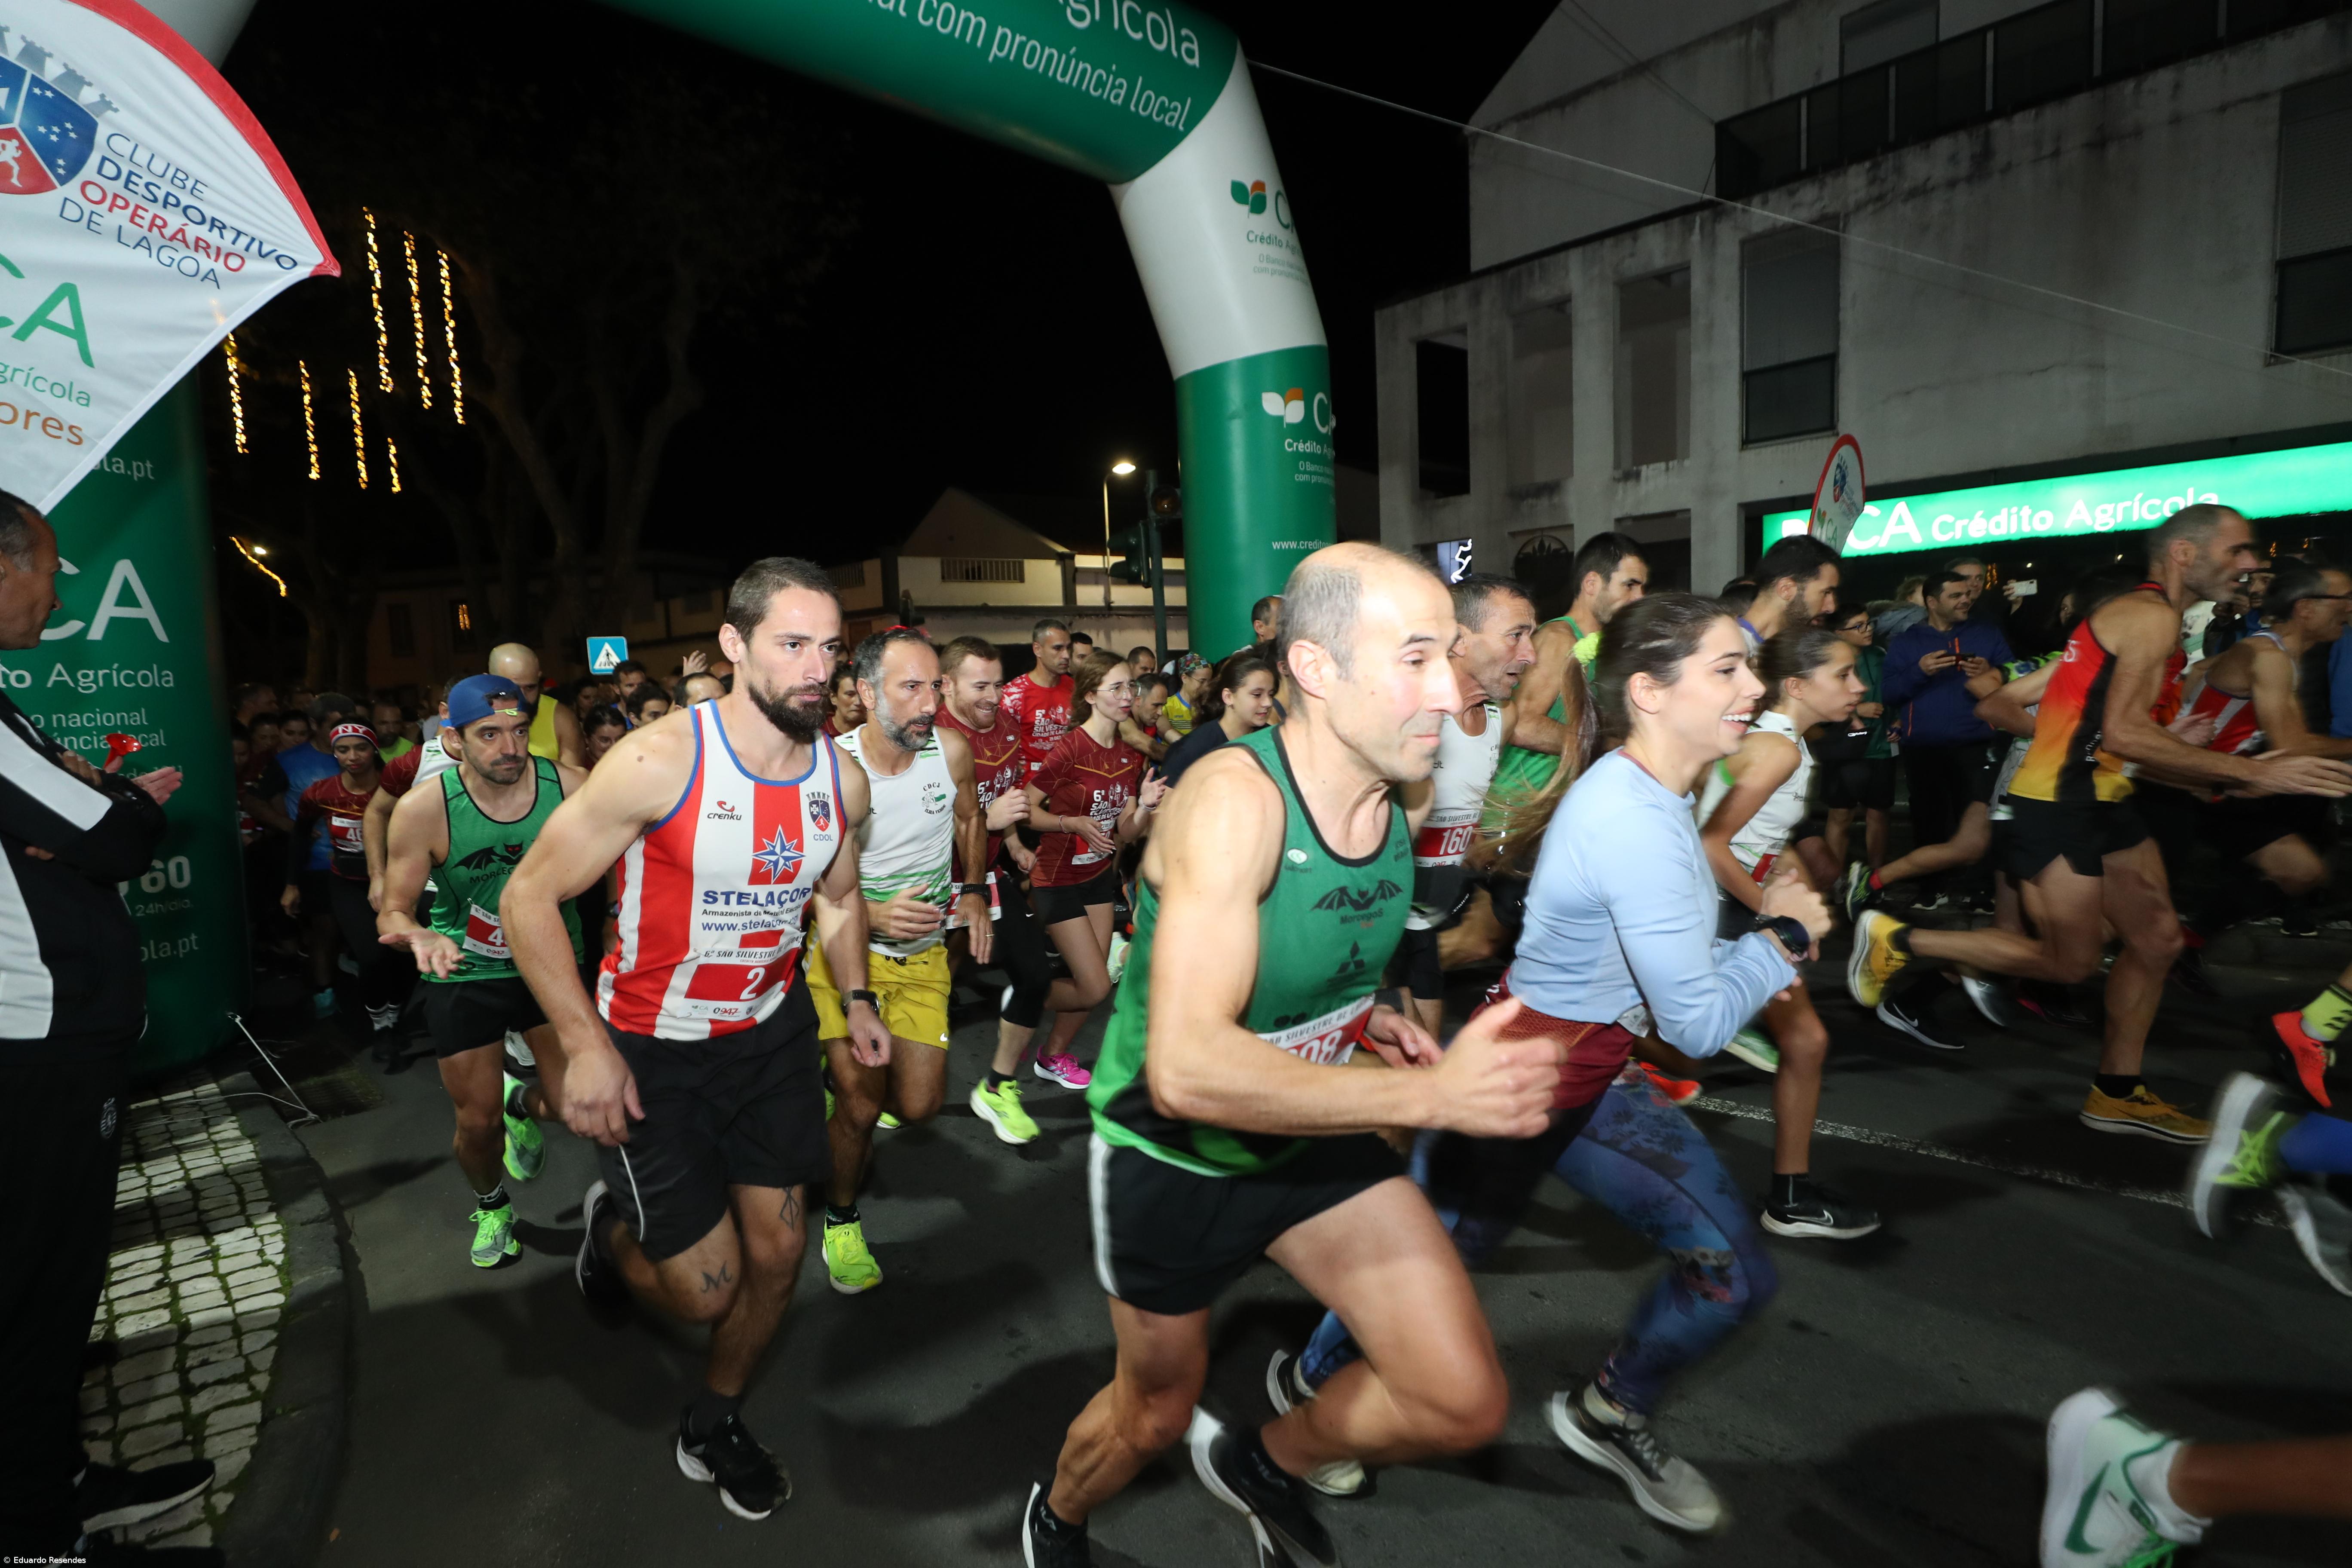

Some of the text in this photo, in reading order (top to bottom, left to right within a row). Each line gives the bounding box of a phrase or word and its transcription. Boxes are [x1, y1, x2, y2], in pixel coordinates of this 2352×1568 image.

[918, 0, 1191, 131] com pronúncia local
[107, 133, 208, 201] CLUBE
[97, 155, 297, 270] DESPORTIVO
[1275, 190, 1294, 233] C
[80, 181, 245, 272] OPERÁRIO
[60, 197, 220, 289] DE LAGOA
[1247, 230, 1283, 248] Crédito
[1285, 438, 1322, 454] Crédito
[1299, 461, 1305, 470] O
[1306, 461, 1324, 473] Banco
[1295, 473, 1311, 482] com
[1847, 501, 1922, 550] CA
[1932, 506, 2054, 542] Crédito
[2064, 487, 2220, 532] Agrícola
[46, 662, 175, 694] Agrícola
[52, 707, 149, 727] nacional
[337, 725, 367, 734] NY
[923, 782, 940, 791] CDCJ
[978, 792, 992, 803] ÃO
[1090, 800, 1108, 811] SÃO
[707, 812, 742, 821] crenku
[1447, 813, 1472, 822] SILVESTRE
[1439, 825, 1473, 855] 160
[141, 855, 191, 893] 60
[702, 888, 812, 909] STELAÇOR
[701, 909, 751, 917] Armazenista
[487, 927, 508, 946] 4
[716, 949, 733, 958] SÃO
[735, 949, 776, 959] SILVESTRE
[739, 967, 766, 1000] 2
[1285, 1017, 1332, 1042] SILVESTRE
[1286, 1029, 1343, 1065] 08
